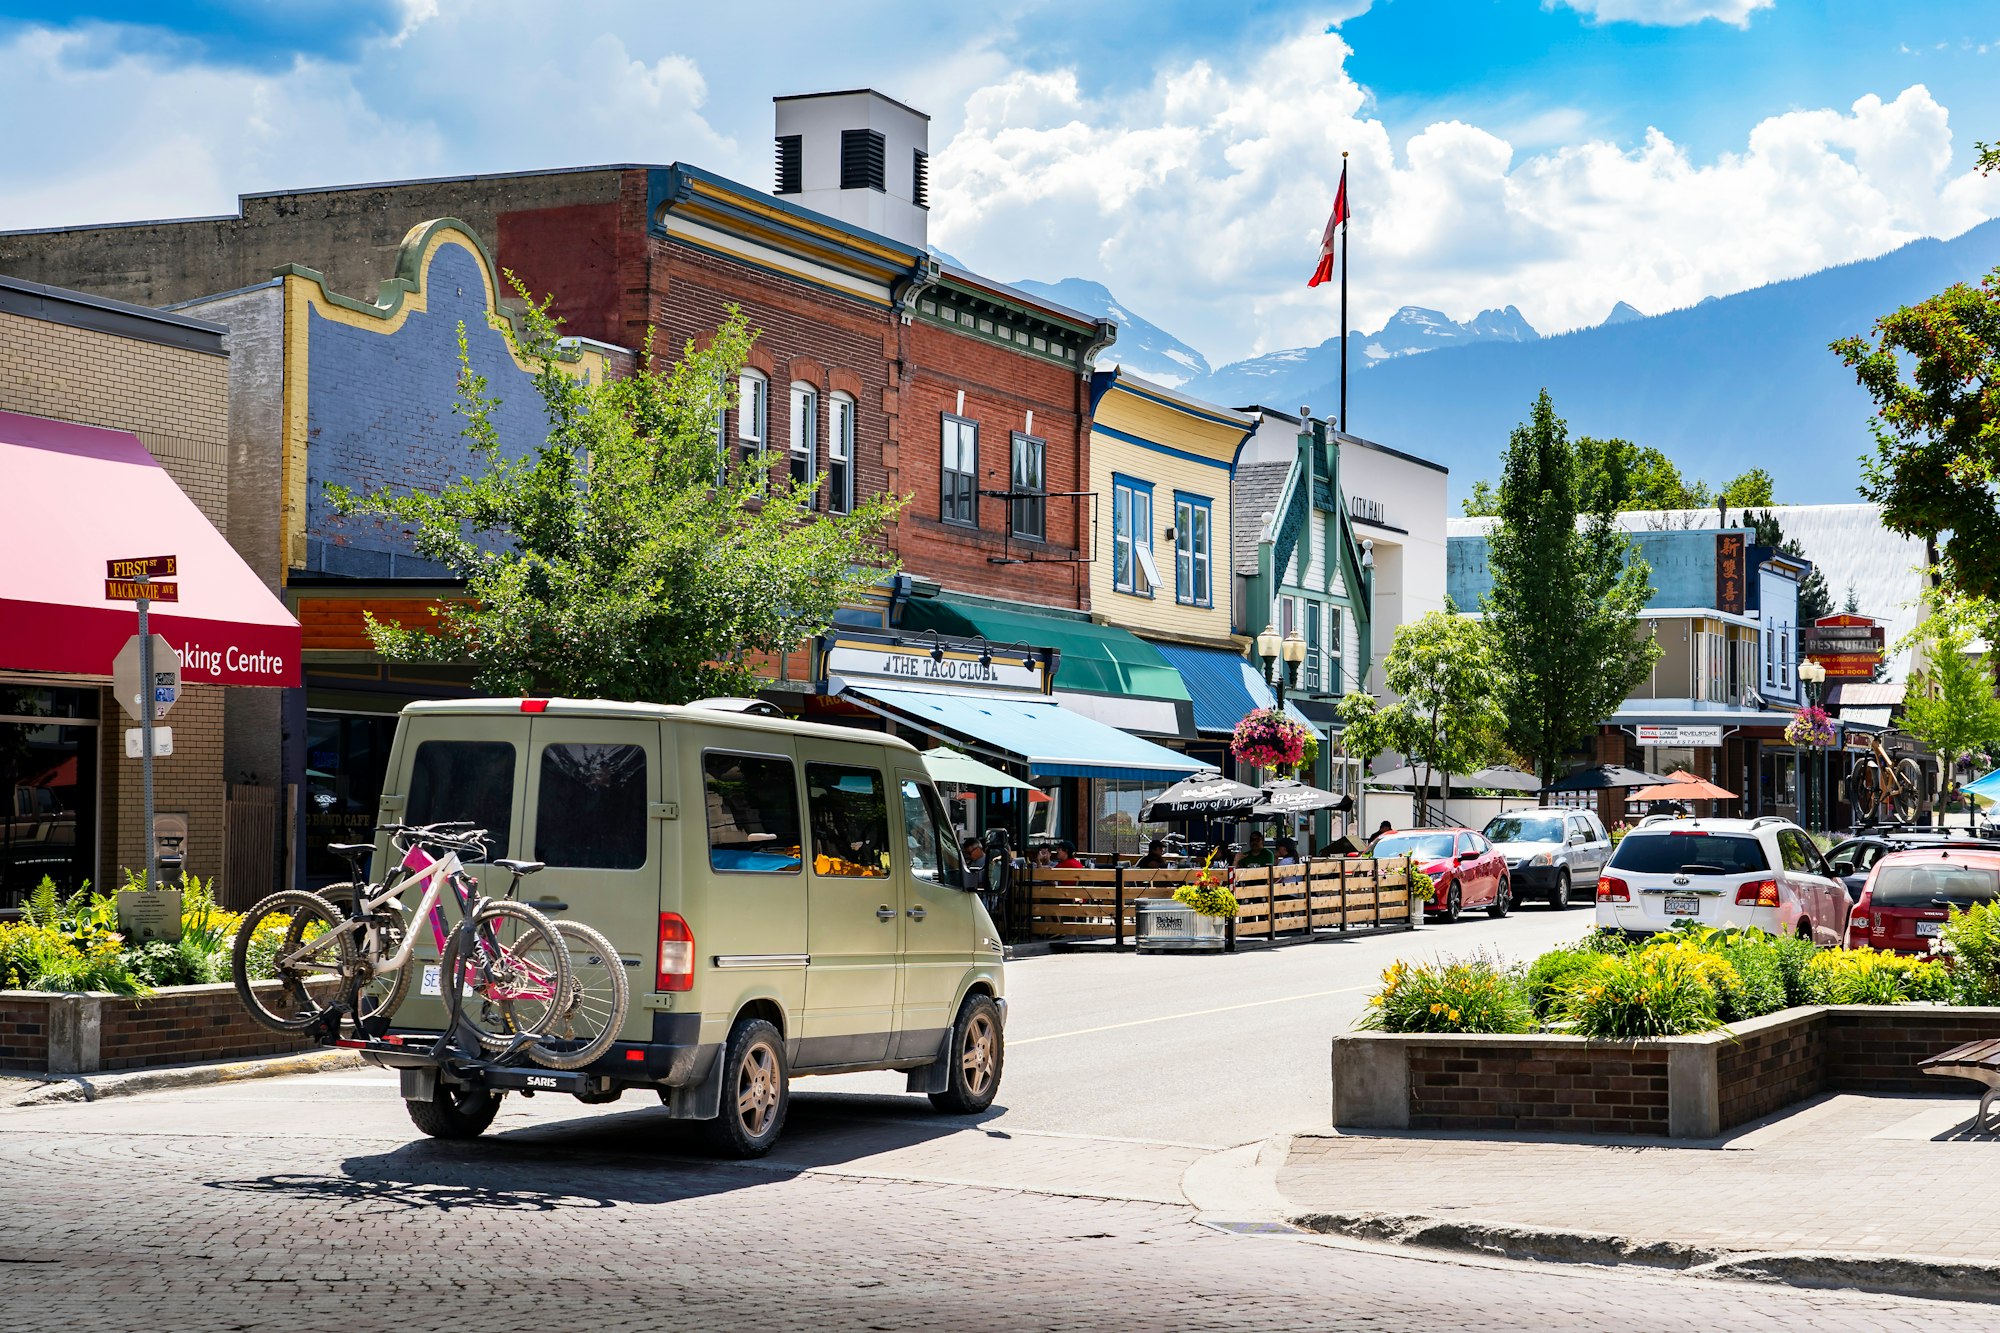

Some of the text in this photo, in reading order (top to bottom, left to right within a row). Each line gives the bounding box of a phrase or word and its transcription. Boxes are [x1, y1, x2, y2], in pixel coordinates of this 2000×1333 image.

[1352, 496, 1384, 524] CITY HALL
[113, 558, 175, 577] FIRST ST E
[109, 582, 174, 599] MACKENZIE AVE
[1809, 640, 1881, 650] RESTAURANT
[174, 642, 283, 676] nking Centre
[892, 655, 990, 681] THE TACO CLUB
[1170, 801, 1188, 812] The
[1190, 800, 1208, 812] Joy
[1210, 799, 1222, 810] of
[256, 898, 286, 916] MAXXIS
[402, 882, 438, 952] NORCO
[527, 1076, 557, 1088] SARIS
